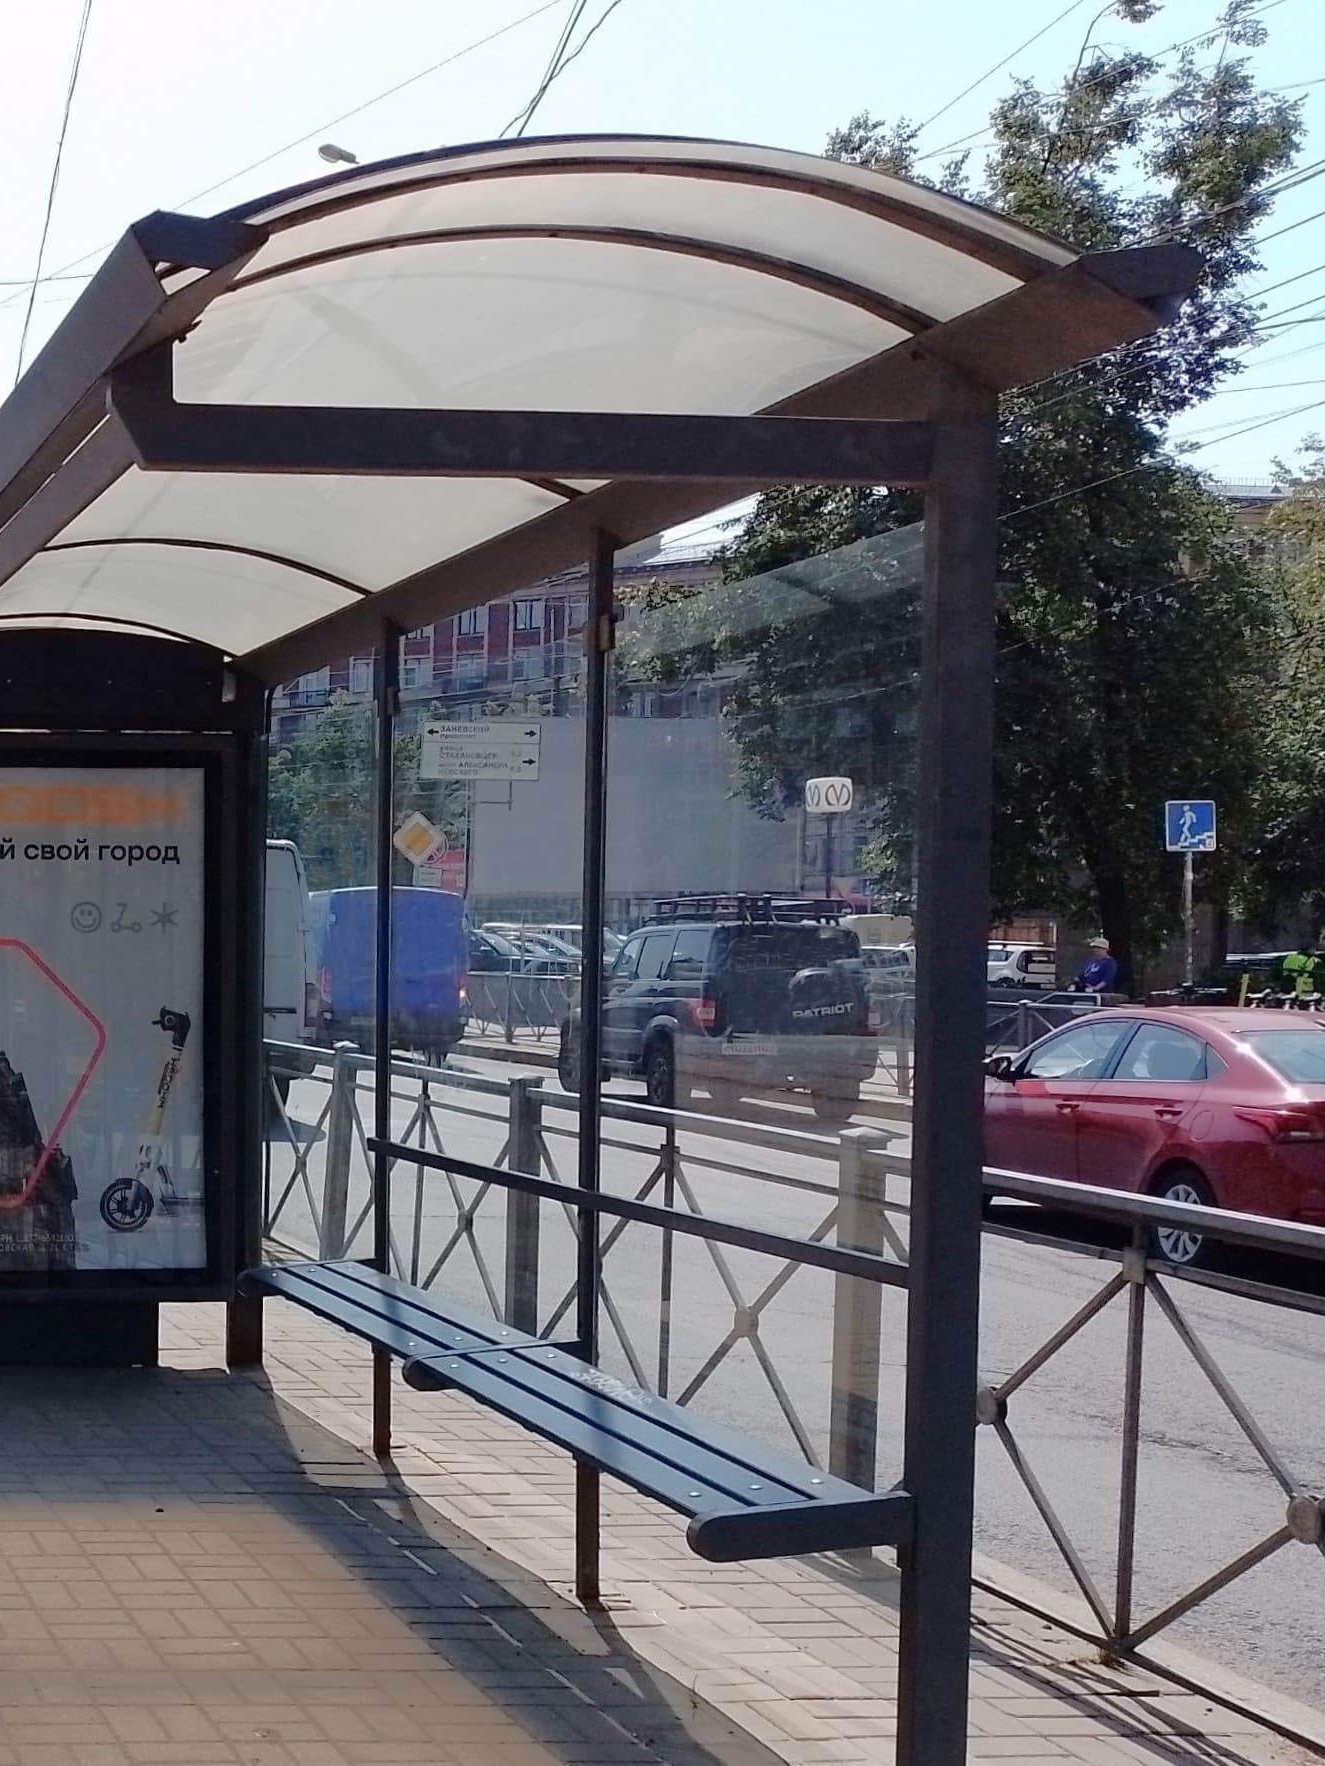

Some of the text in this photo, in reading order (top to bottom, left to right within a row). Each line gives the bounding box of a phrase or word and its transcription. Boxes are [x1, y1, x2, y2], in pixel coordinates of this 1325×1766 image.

[24, 838, 90, 862] свой
[98, 841, 181, 867] город
[792, 1002, 855, 1019] PATRIOT
